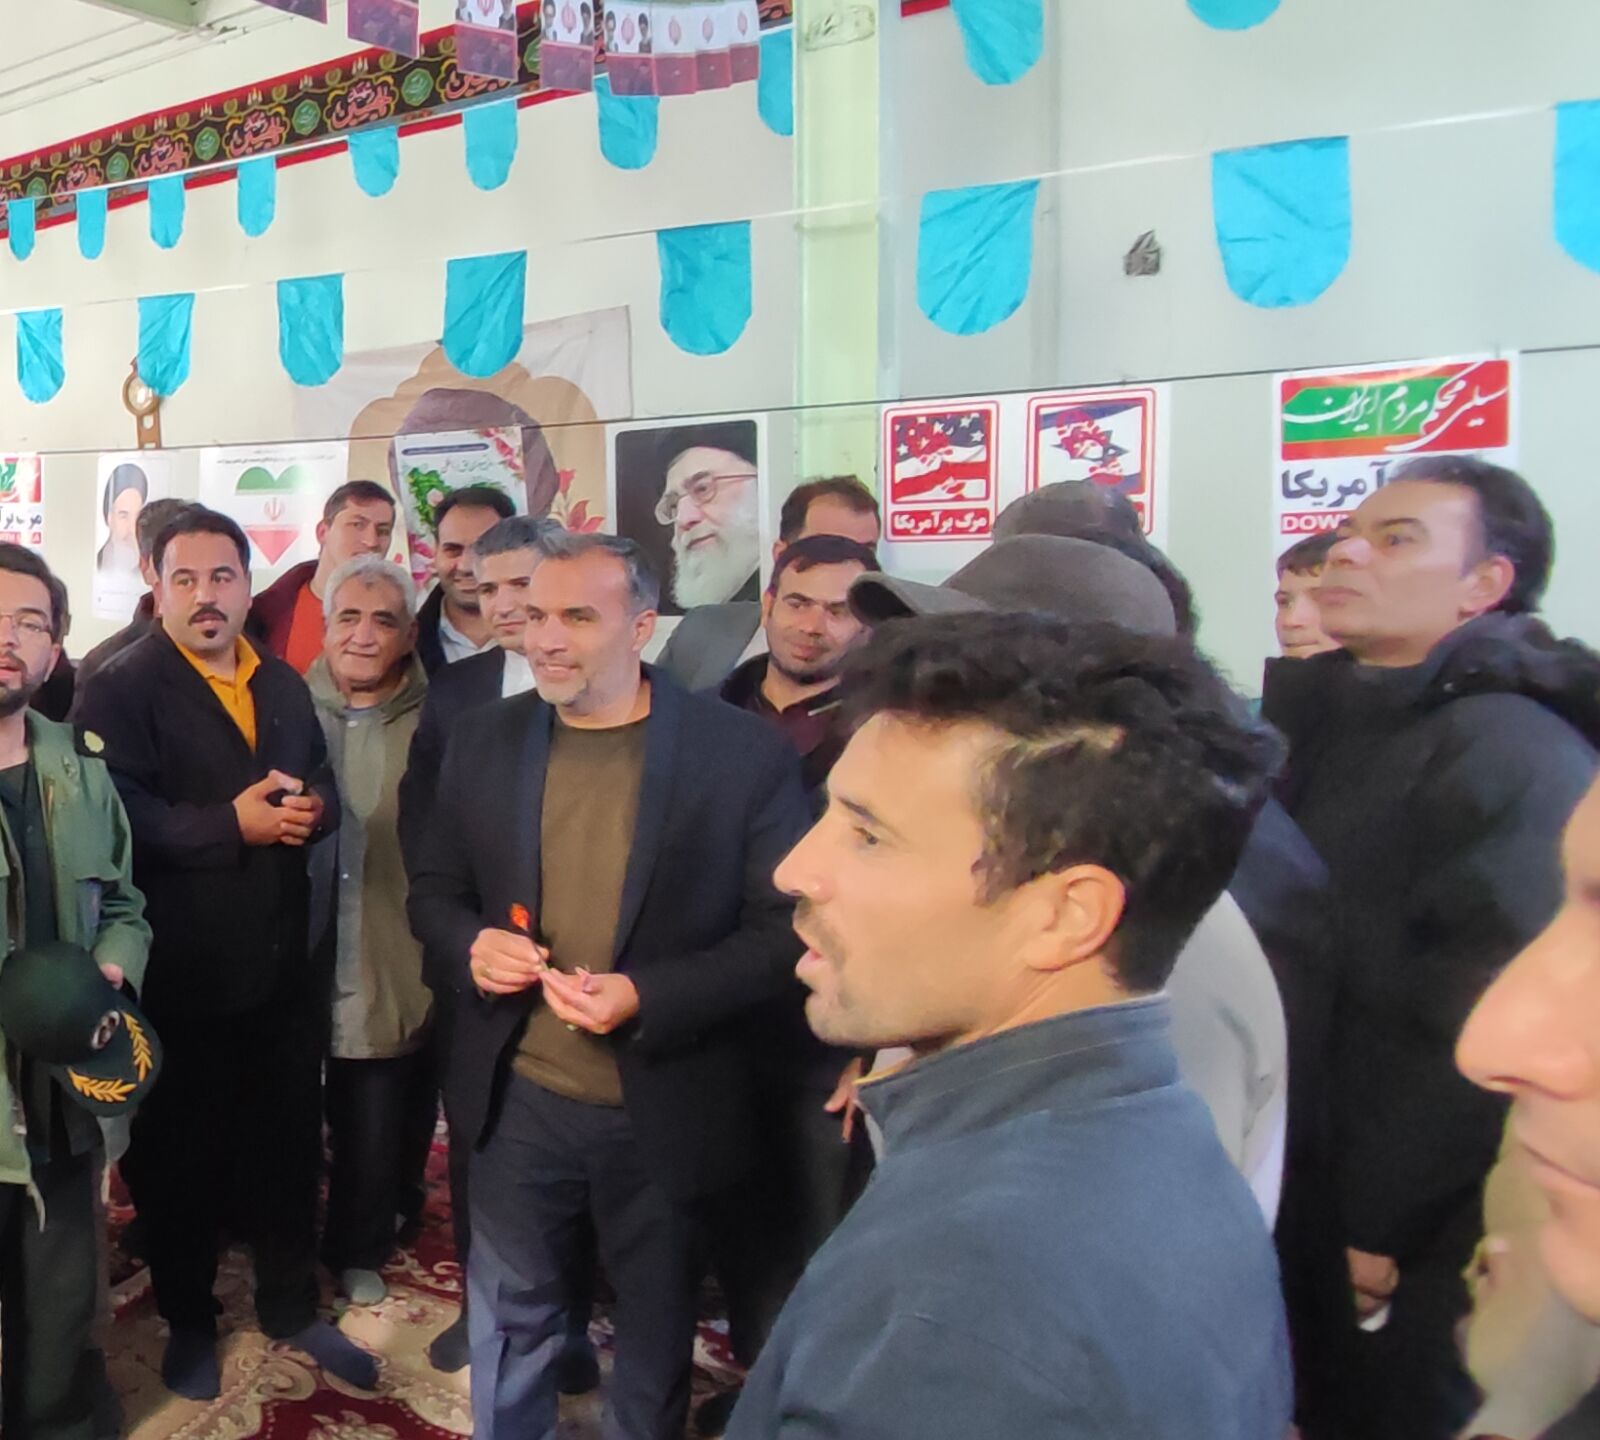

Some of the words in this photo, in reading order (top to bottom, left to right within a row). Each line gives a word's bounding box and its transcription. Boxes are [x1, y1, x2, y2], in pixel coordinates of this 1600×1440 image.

[1281, 383, 1381, 433] ایران
[1376, 385, 1429, 437] مردم
[1281, 459, 1393, 508] آمریکا
